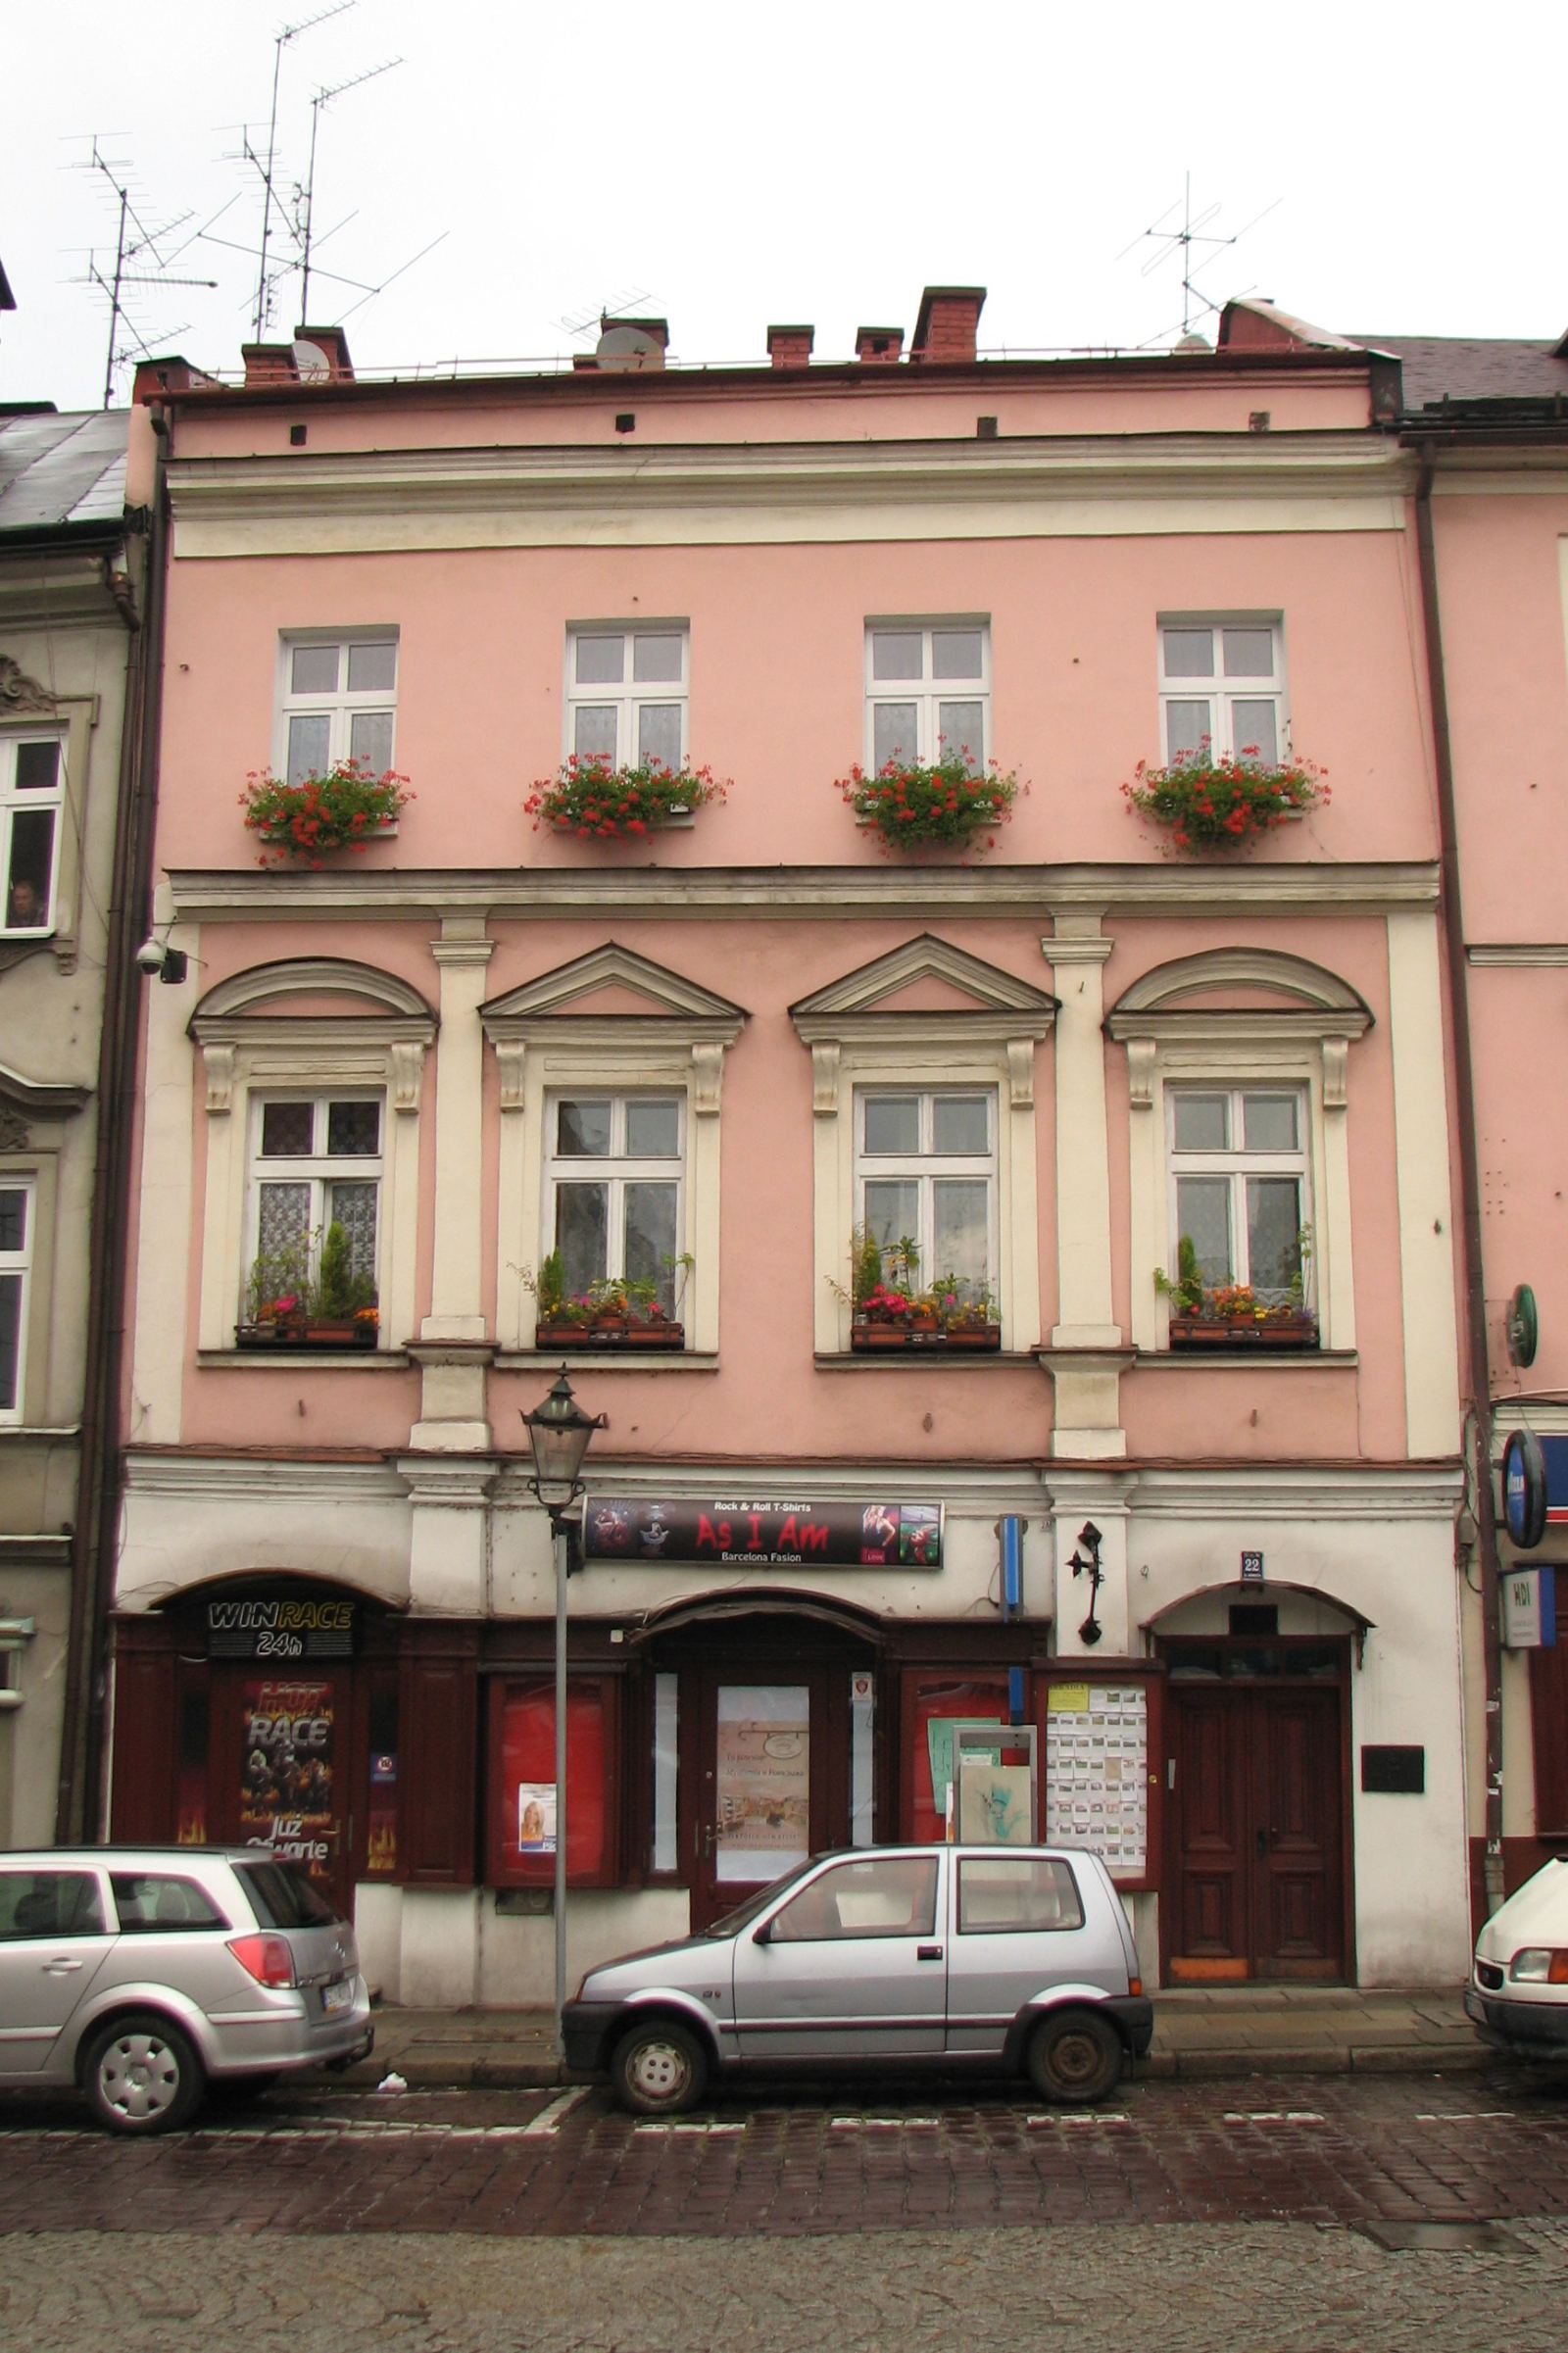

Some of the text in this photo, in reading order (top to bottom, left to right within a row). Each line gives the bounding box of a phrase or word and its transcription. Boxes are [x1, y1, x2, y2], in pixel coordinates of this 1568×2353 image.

[714, 1501, 811, 1512] Rock & Roll T-Shirts
[696, 1513, 829, 1551] As I Am
[721, 1551, 802, 1562] Barcelona Fasion
[1245, 1558, 1260, 1572] 22
[257, 1631, 303, 1656] 24h
[249, 1716, 330, 1745] RACE
[270, 1813, 303, 1840] Już
